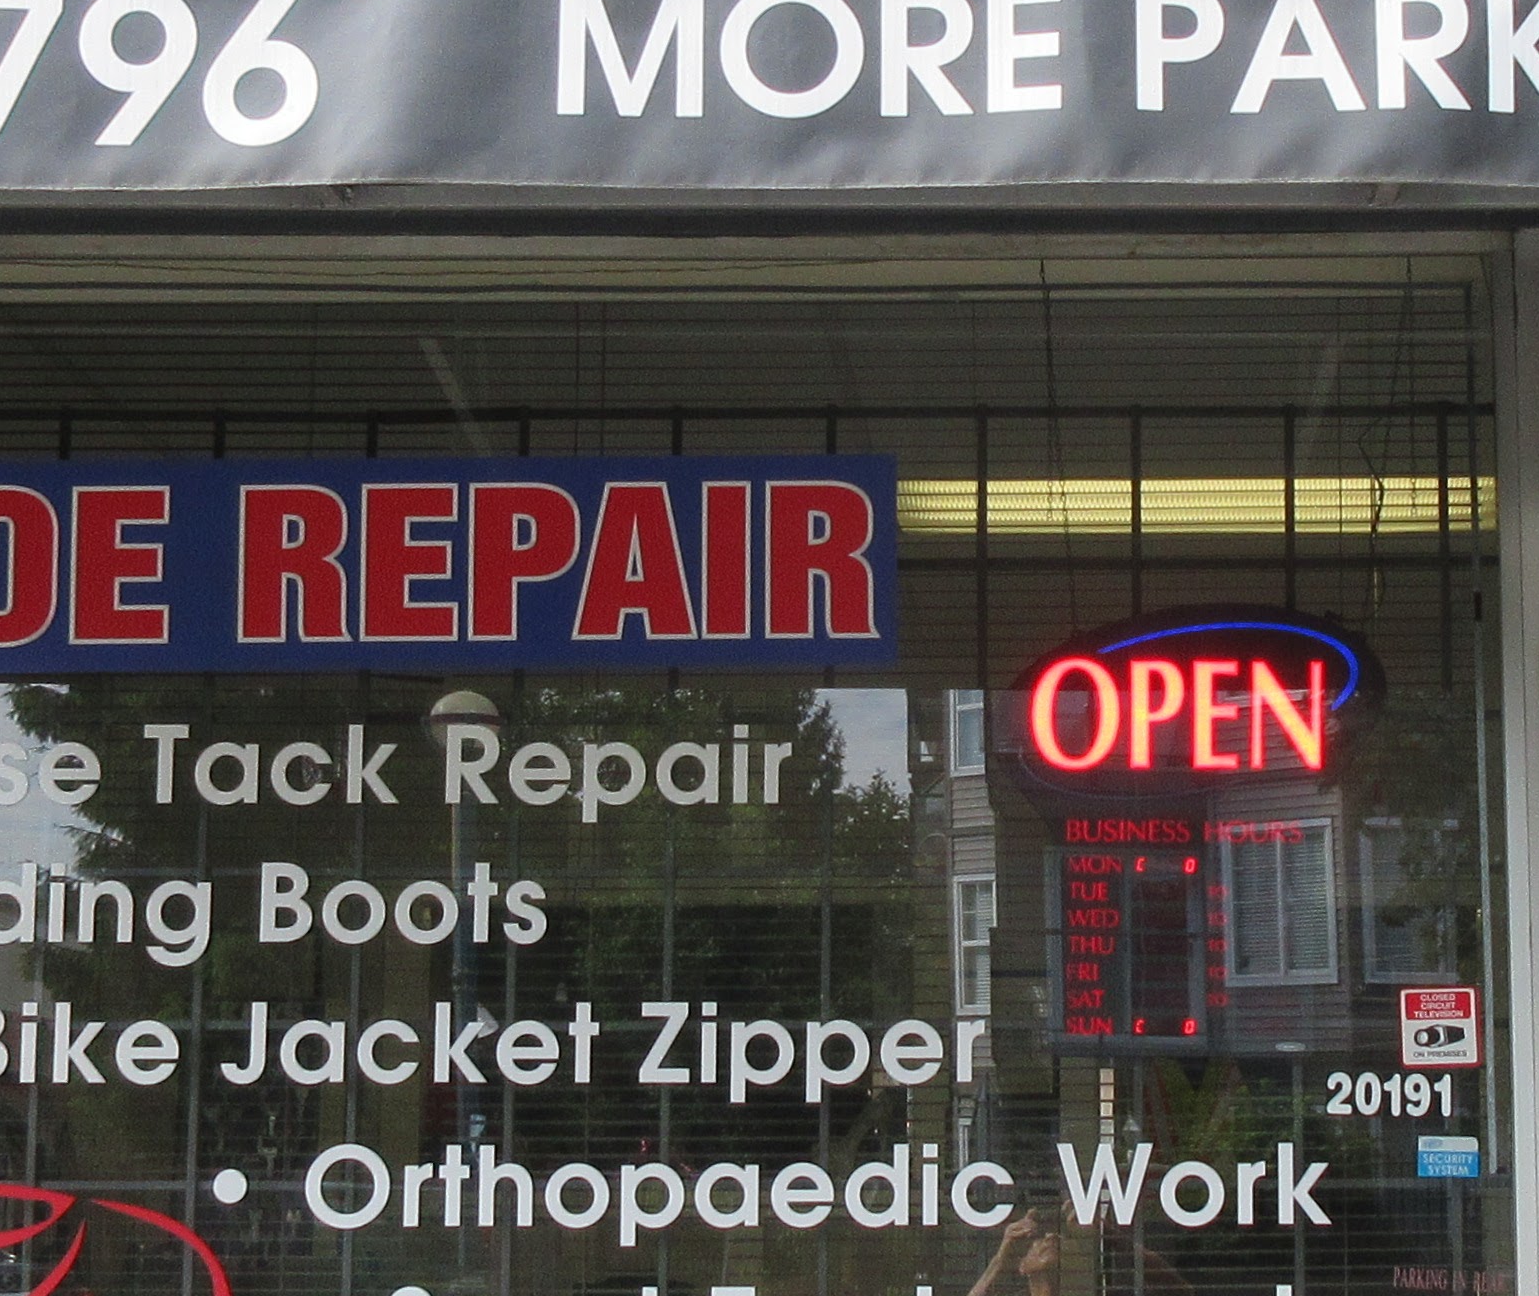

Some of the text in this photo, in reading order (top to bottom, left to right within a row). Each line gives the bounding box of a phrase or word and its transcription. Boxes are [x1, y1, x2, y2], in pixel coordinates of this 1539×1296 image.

[236, 481, 880, 644] REPAIR
[1030, 657, 1324, 771] OPEN
[143, 723, 399, 807] Tack
[443, 722, 793, 824] Repair
[1067, 819, 1303, 843] BUSINESS HOURS
[1067, 857, 1123, 873] MON
[1070, 882, 1109, 901] TUE
[258, 862, 549, 946] Boots
[1067, 909, 1120, 928] WED
[1069, 936, 1115, 955] THU
[1067, 963, 1100, 981] FRI
[1067, 990, 1105, 1008] SAT
[1421, 993, 1456, 1001] CLOSED
[1421, 1002, 1456, 1010] CIRCUIT
[1414, 1010, 1464, 1018] TELEVISION
[1067, 1017, 1113, 1035] SUN
[220, 1001, 601, 1086] Jacket
[639, 1001, 989, 1102] Zipper
[1326, 1071, 1452, 1118] 20191
[1423, 1154, 1473, 1164] SECURITY
[1427, 1165, 1469, 1175] SYSTEM
[302, 1141, 1332, 1247] Orthopaedic Work
